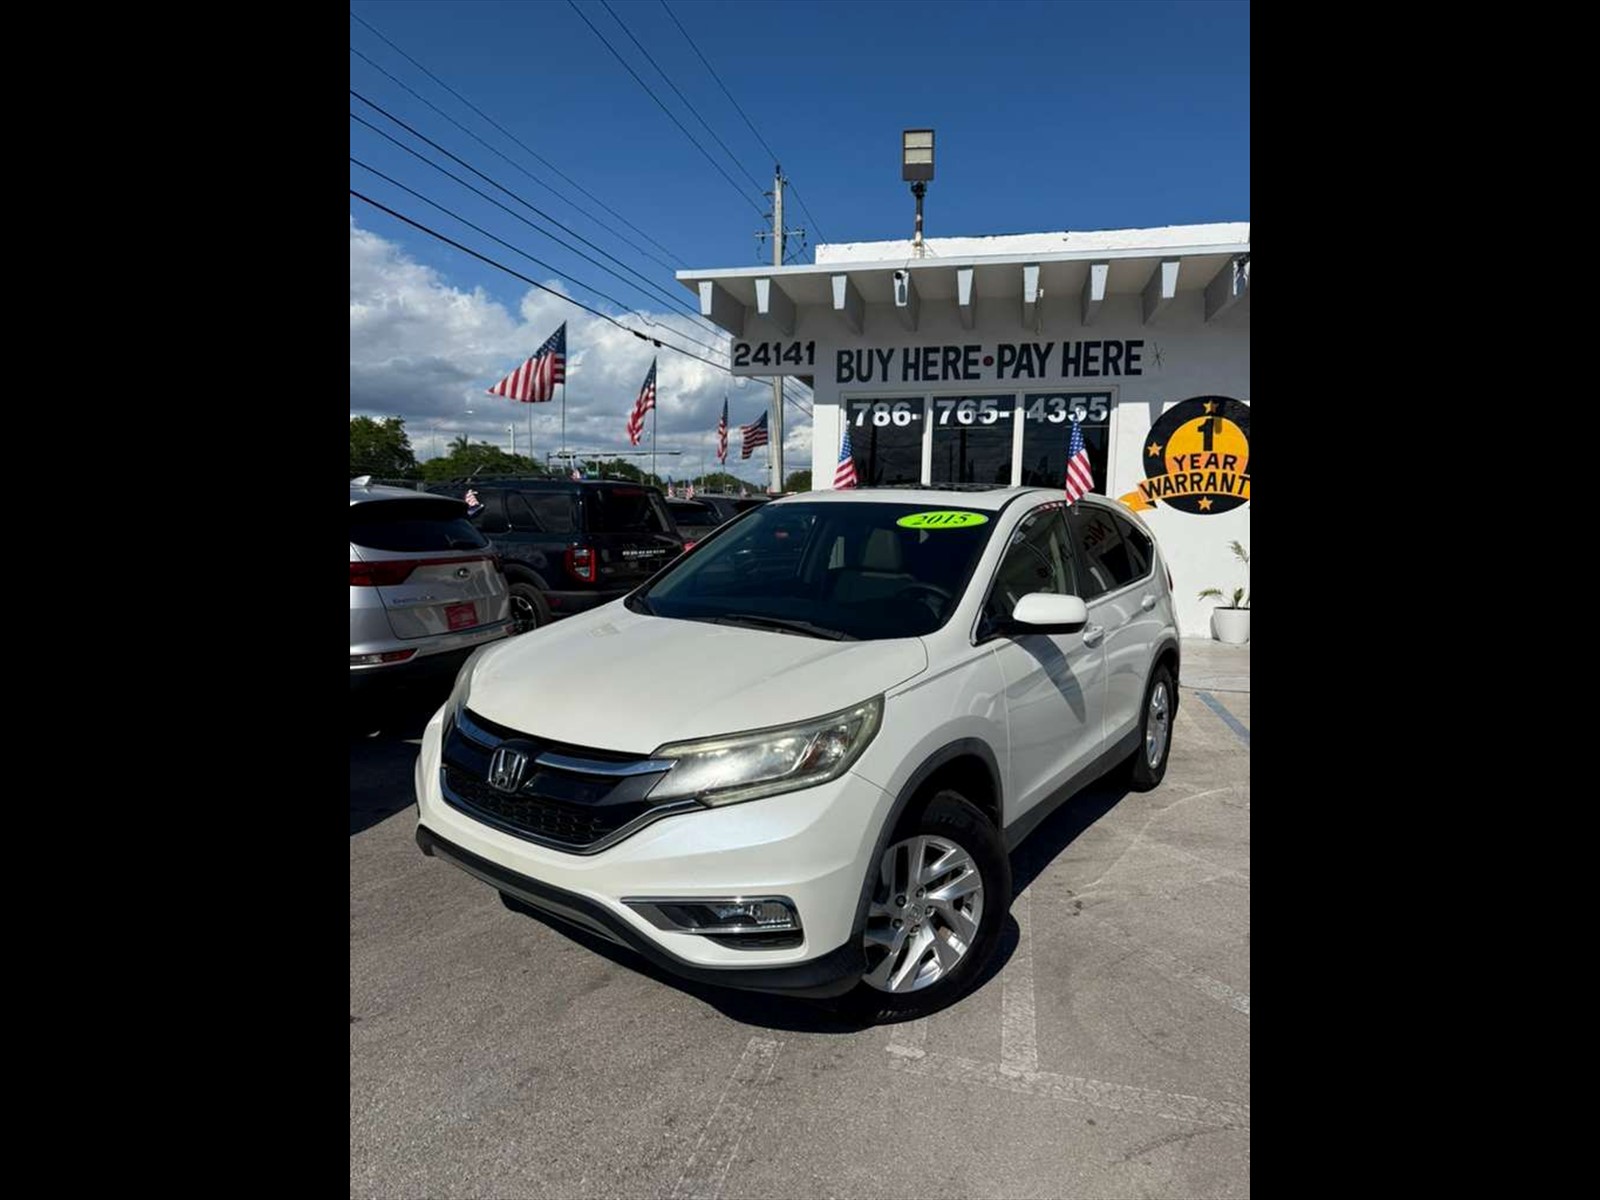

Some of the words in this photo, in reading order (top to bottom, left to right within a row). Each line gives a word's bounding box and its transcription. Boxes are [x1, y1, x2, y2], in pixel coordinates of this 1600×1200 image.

[734, 341, 816, 367] 24141
[836, 347, 896, 384] BUY
[902, 344, 982, 382] HERE
[997, 342, 1055, 379] PAY
[1061, 340, 1145, 377] HERE
[1026, 396, 1108, 423] 4355
[1197, 417, 1215, 452] 1
[1172, 452, 1238, 472] YEAR
[911, 514, 972, 526] 2015
